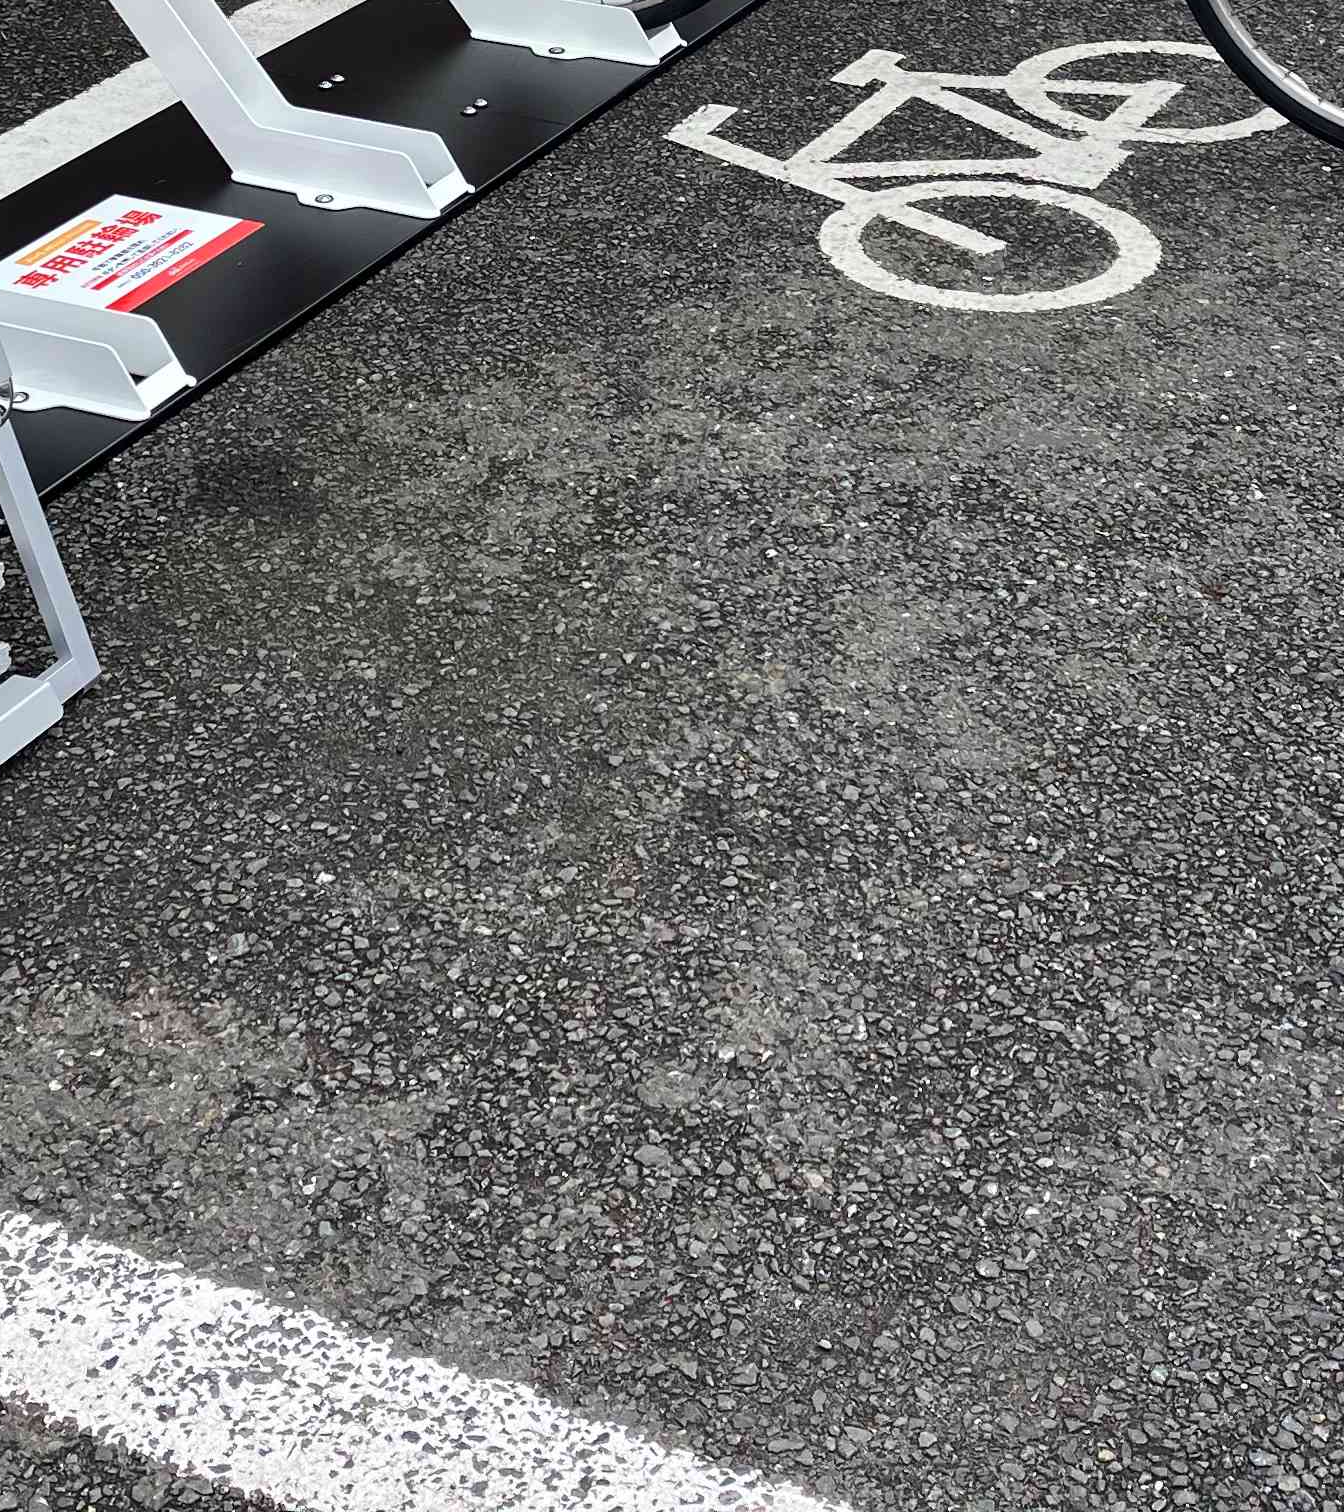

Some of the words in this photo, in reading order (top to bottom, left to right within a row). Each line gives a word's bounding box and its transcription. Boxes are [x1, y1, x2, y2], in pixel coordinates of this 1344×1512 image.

[13, 209, 163, 289] 専用駐輪場
